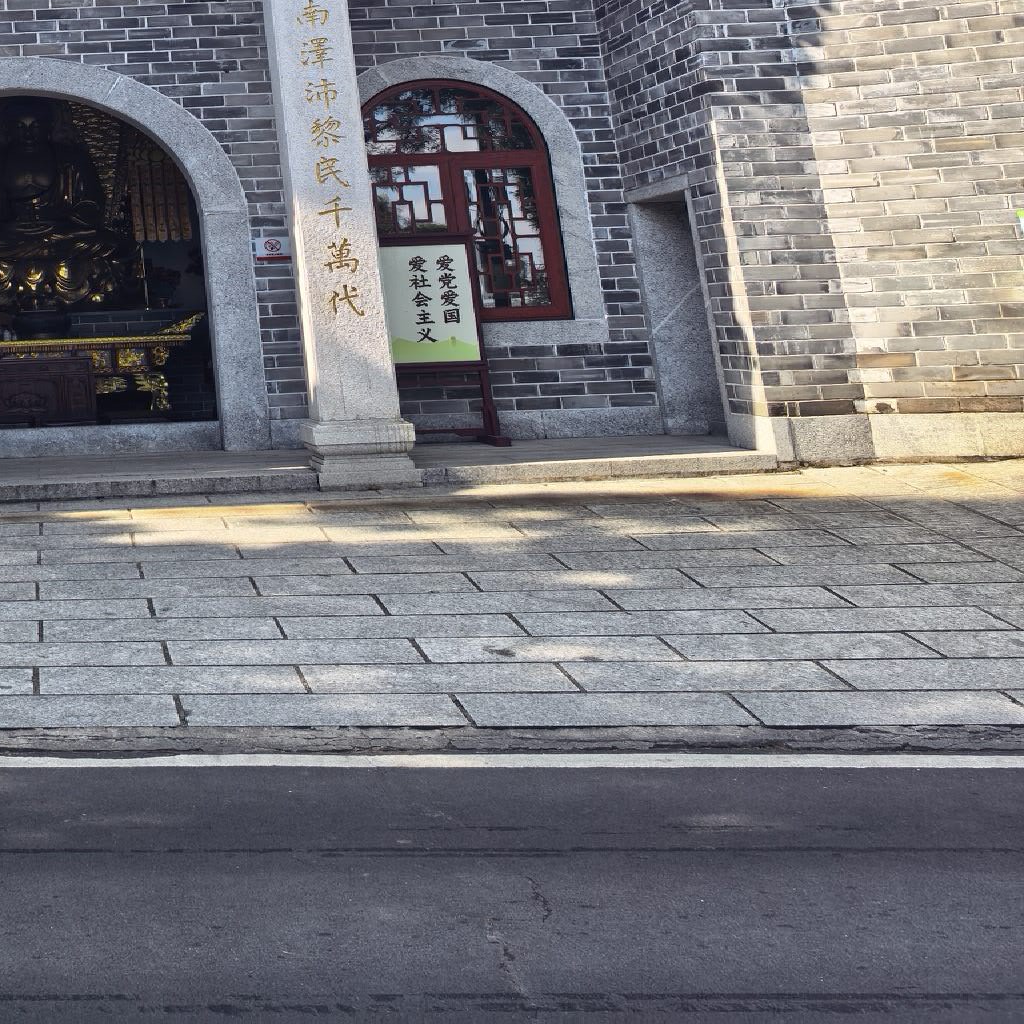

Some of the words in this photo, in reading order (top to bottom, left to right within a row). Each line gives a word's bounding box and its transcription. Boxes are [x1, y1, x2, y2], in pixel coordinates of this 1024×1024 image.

[408, 255, 438, 343] 爱社会主义
[436, 254, 461, 324] 爱党爱国
